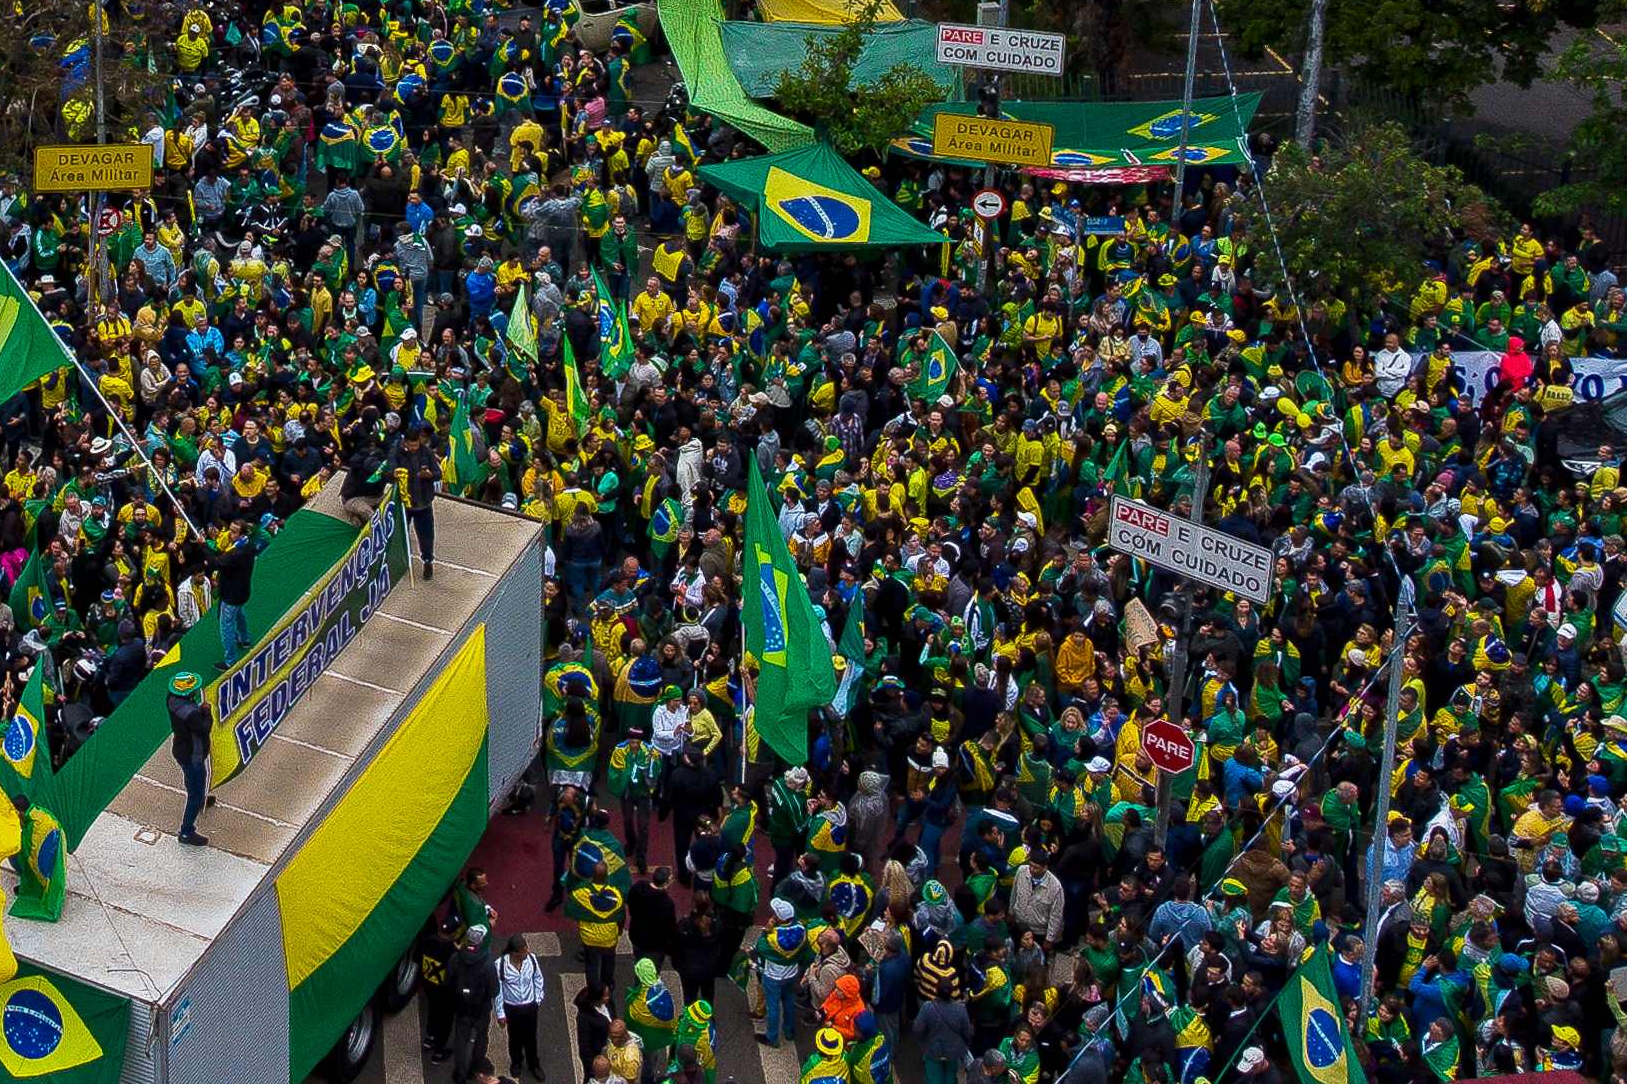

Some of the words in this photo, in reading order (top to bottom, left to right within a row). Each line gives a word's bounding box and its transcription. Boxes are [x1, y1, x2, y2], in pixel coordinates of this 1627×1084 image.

[942, 29, 983, 44] PARE
[990, 34, 1000, 45] E
[1008, 35, 1060, 52] CRUZE
[943, 47, 978, 61] COM
[986, 51, 1056, 68] CUIDADO
[957, 122, 1034, 142] DEVAGAR
[948, 136, 982, 152] Área
[989, 141, 1039, 157] Militar
[58, 152, 134, 166] DEVAGAR
[49, 167, 85, 182] Área
[91, 168, 140, 181] Militar
[1116, 504, 1168, 534] PARE
[1178, 525, 1190, 543] E
[1200, 537, 1268, 571] CRUZE
[1118, 529, 1162, 557] COM
[1171, 549, 1260, 593] CUIDADO
[218, 499, 396, 723] INTERVENÇÃO
[234, 610, 356, 765] FEDERAL
[1146, 733, 1190, 759] PARE
